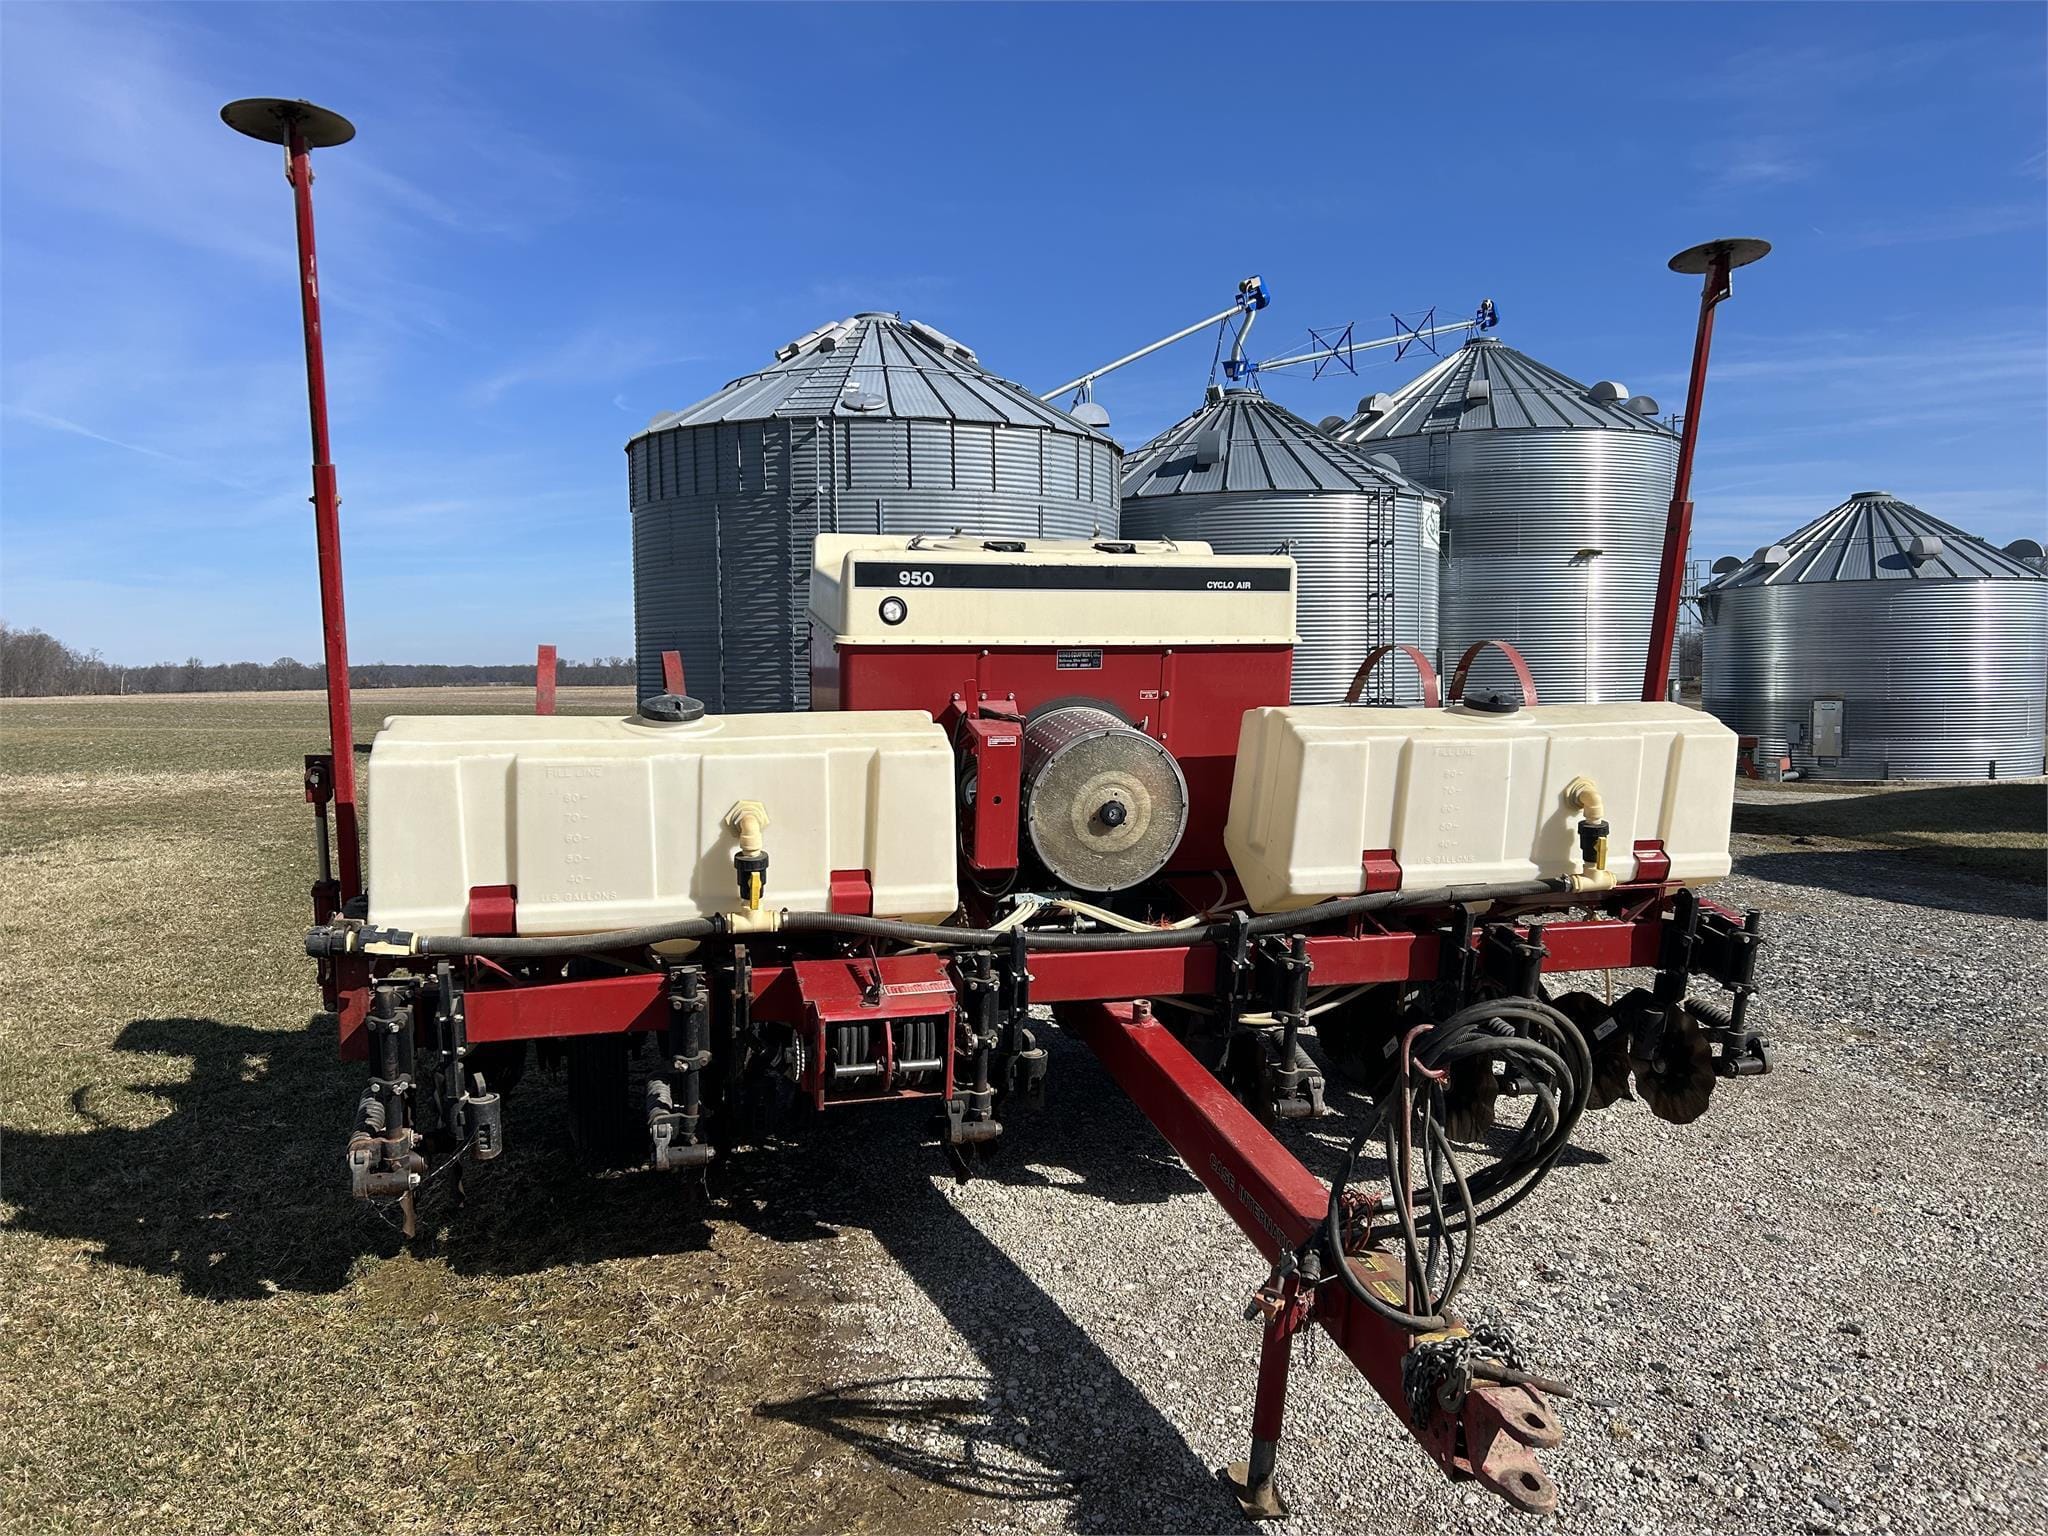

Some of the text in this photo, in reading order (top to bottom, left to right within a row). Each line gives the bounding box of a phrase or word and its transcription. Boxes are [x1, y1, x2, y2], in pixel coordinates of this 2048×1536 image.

[898, 571, 934, 585] 950
[1206, 581, 1234, 589] CYCLO
[544, 767, 602, 778] FILL LINE
[1433, 855, 1476, 864] GALLONS
[562, 890, 617, 902] GALLONS
[1209, 1152, 1296, 1251] CASE INTERNATIO
